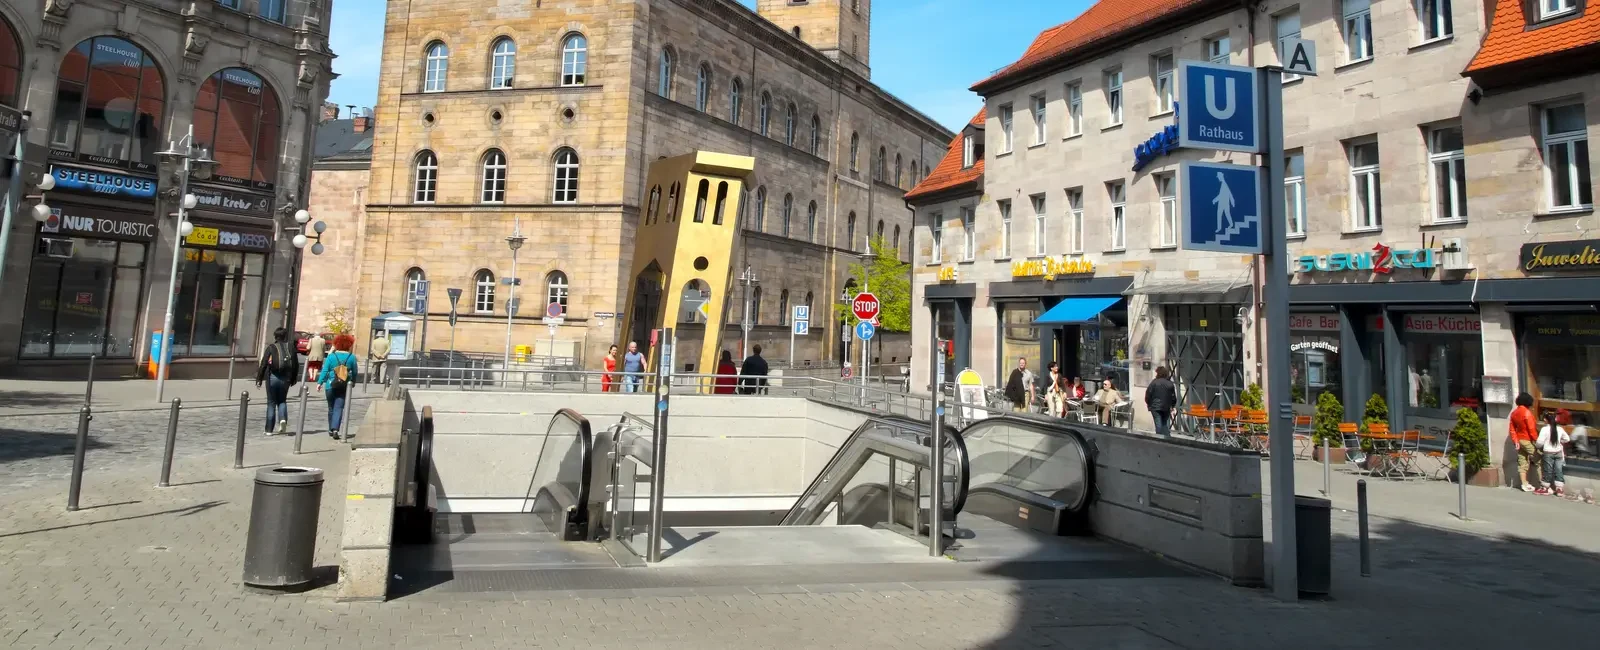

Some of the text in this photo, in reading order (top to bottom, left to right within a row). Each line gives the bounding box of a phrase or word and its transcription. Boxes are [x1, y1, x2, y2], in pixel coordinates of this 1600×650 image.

[96, 43, 138, 59] STEELHOUSE
[1289, 43, 1312, 71] A
[225, 73, 260, 86] STEELHOUSE
[1204, 74, 1237, 120] U
[1199, 124, 1244, 141] Rathaus
[88, 155, 119, 165] Cocktails
[59, 169, 151, 192] STEELHOUSE
[62, 214, 155, 238] NUR TOURISTIC
[799, 307, 806, 315] U
[854, 301, 877, 313] STOP
[1288, 315, 1339, 328] Cafe Bar
[1405, 315, 1481, 331] Asia-Küche
[1290, 340, 1339, 354] Garten geöffnet
